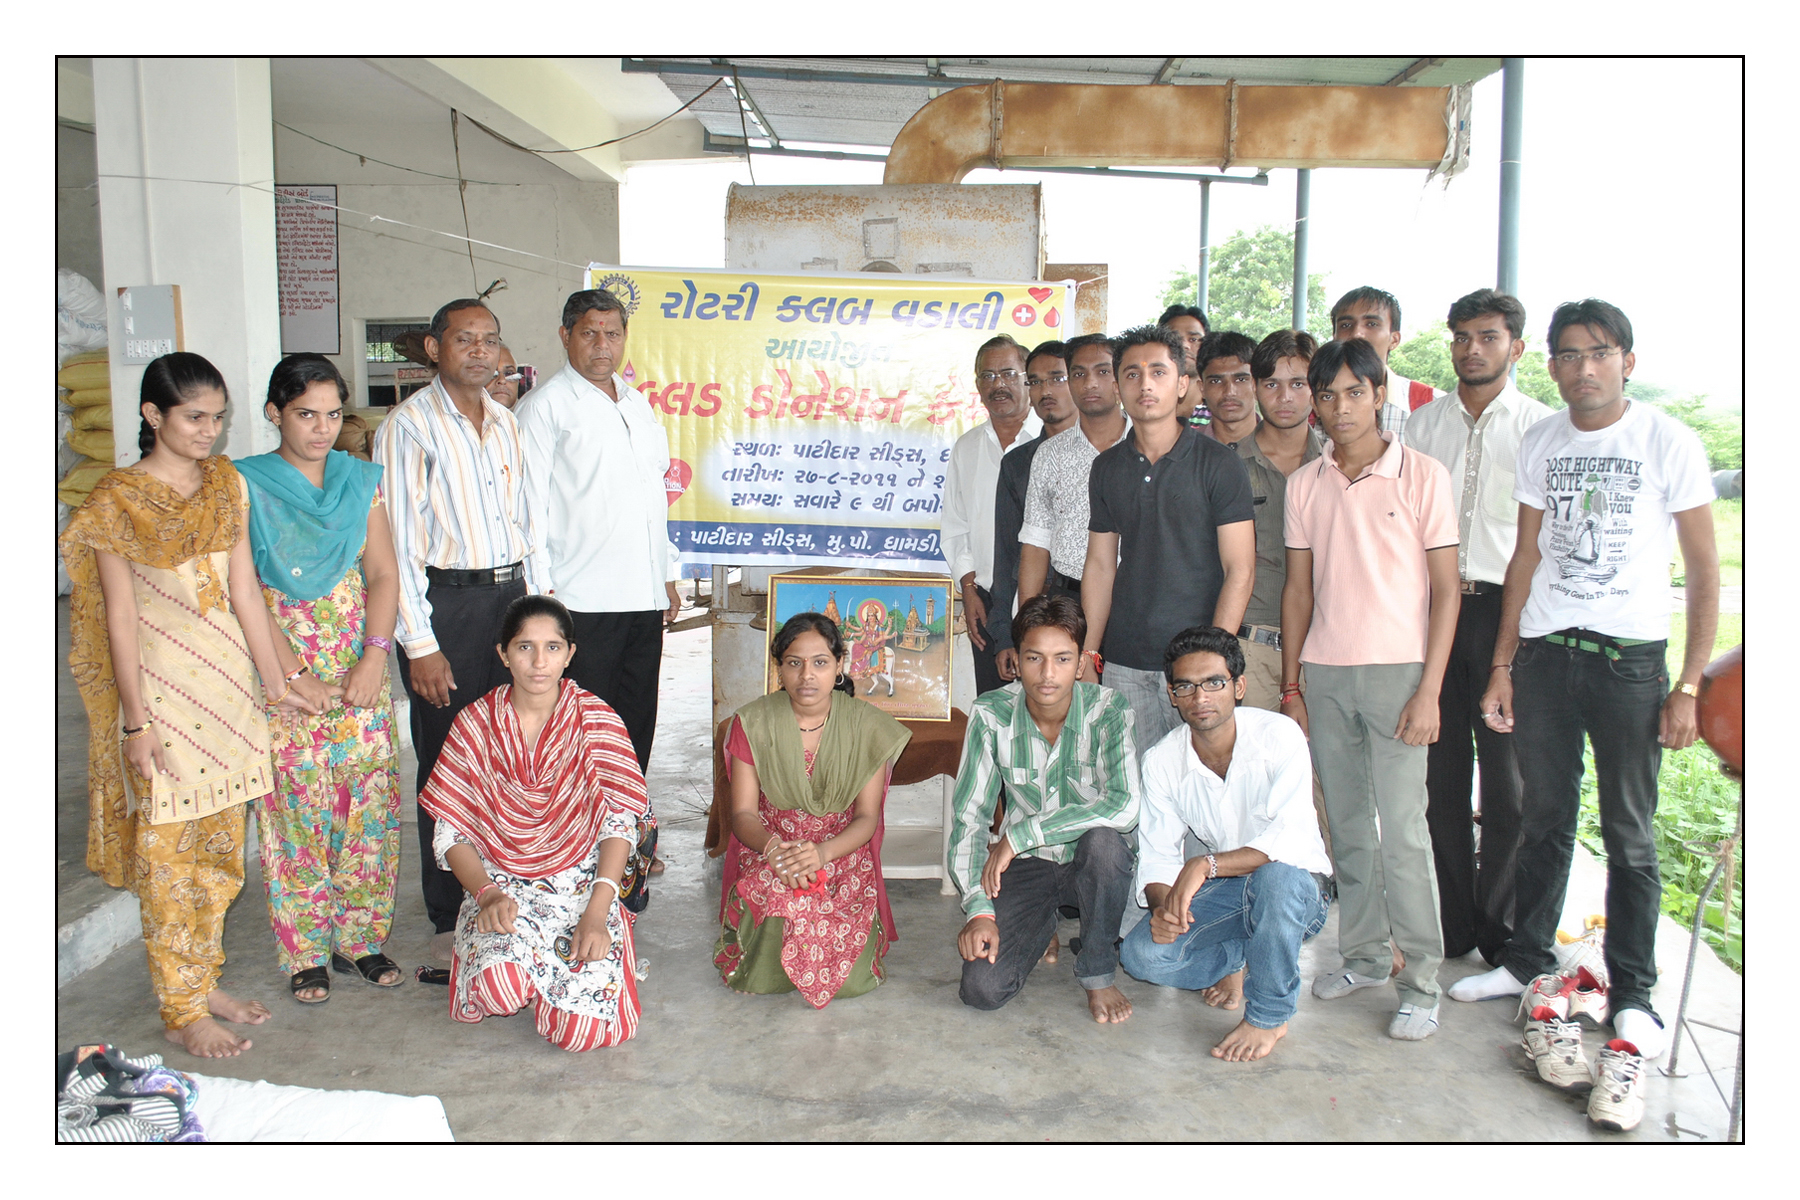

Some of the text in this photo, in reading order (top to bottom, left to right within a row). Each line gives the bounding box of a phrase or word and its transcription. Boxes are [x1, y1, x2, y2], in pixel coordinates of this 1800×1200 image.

[660, 279, 760, 321] રોટરી
[891, 291, 1004, 330] વડાલી
[743, 369, 908, 423] ડોનેશન
[793, 439, 860, 460] પાટીદાર
[1573, 457, 1643, 476] HIGHTWAY
[907, 468, 925, 487] ને
[794, 489, 842, 510] સવારે
[872, 492, 895, 512] થી
[902, 493, 943, 513] બપો
[1546, 495, 1574, 522] 97
[1609, 503, 1632, 518] you
[690, 526, 753, 546] પાટીદાર
[1606, 554, 1627, 562] RIGHT
[1571, 591, 1585, 600] Goes
[1585, 592, 1595, 600] In
[1610, 587, 1629, 597] Days
